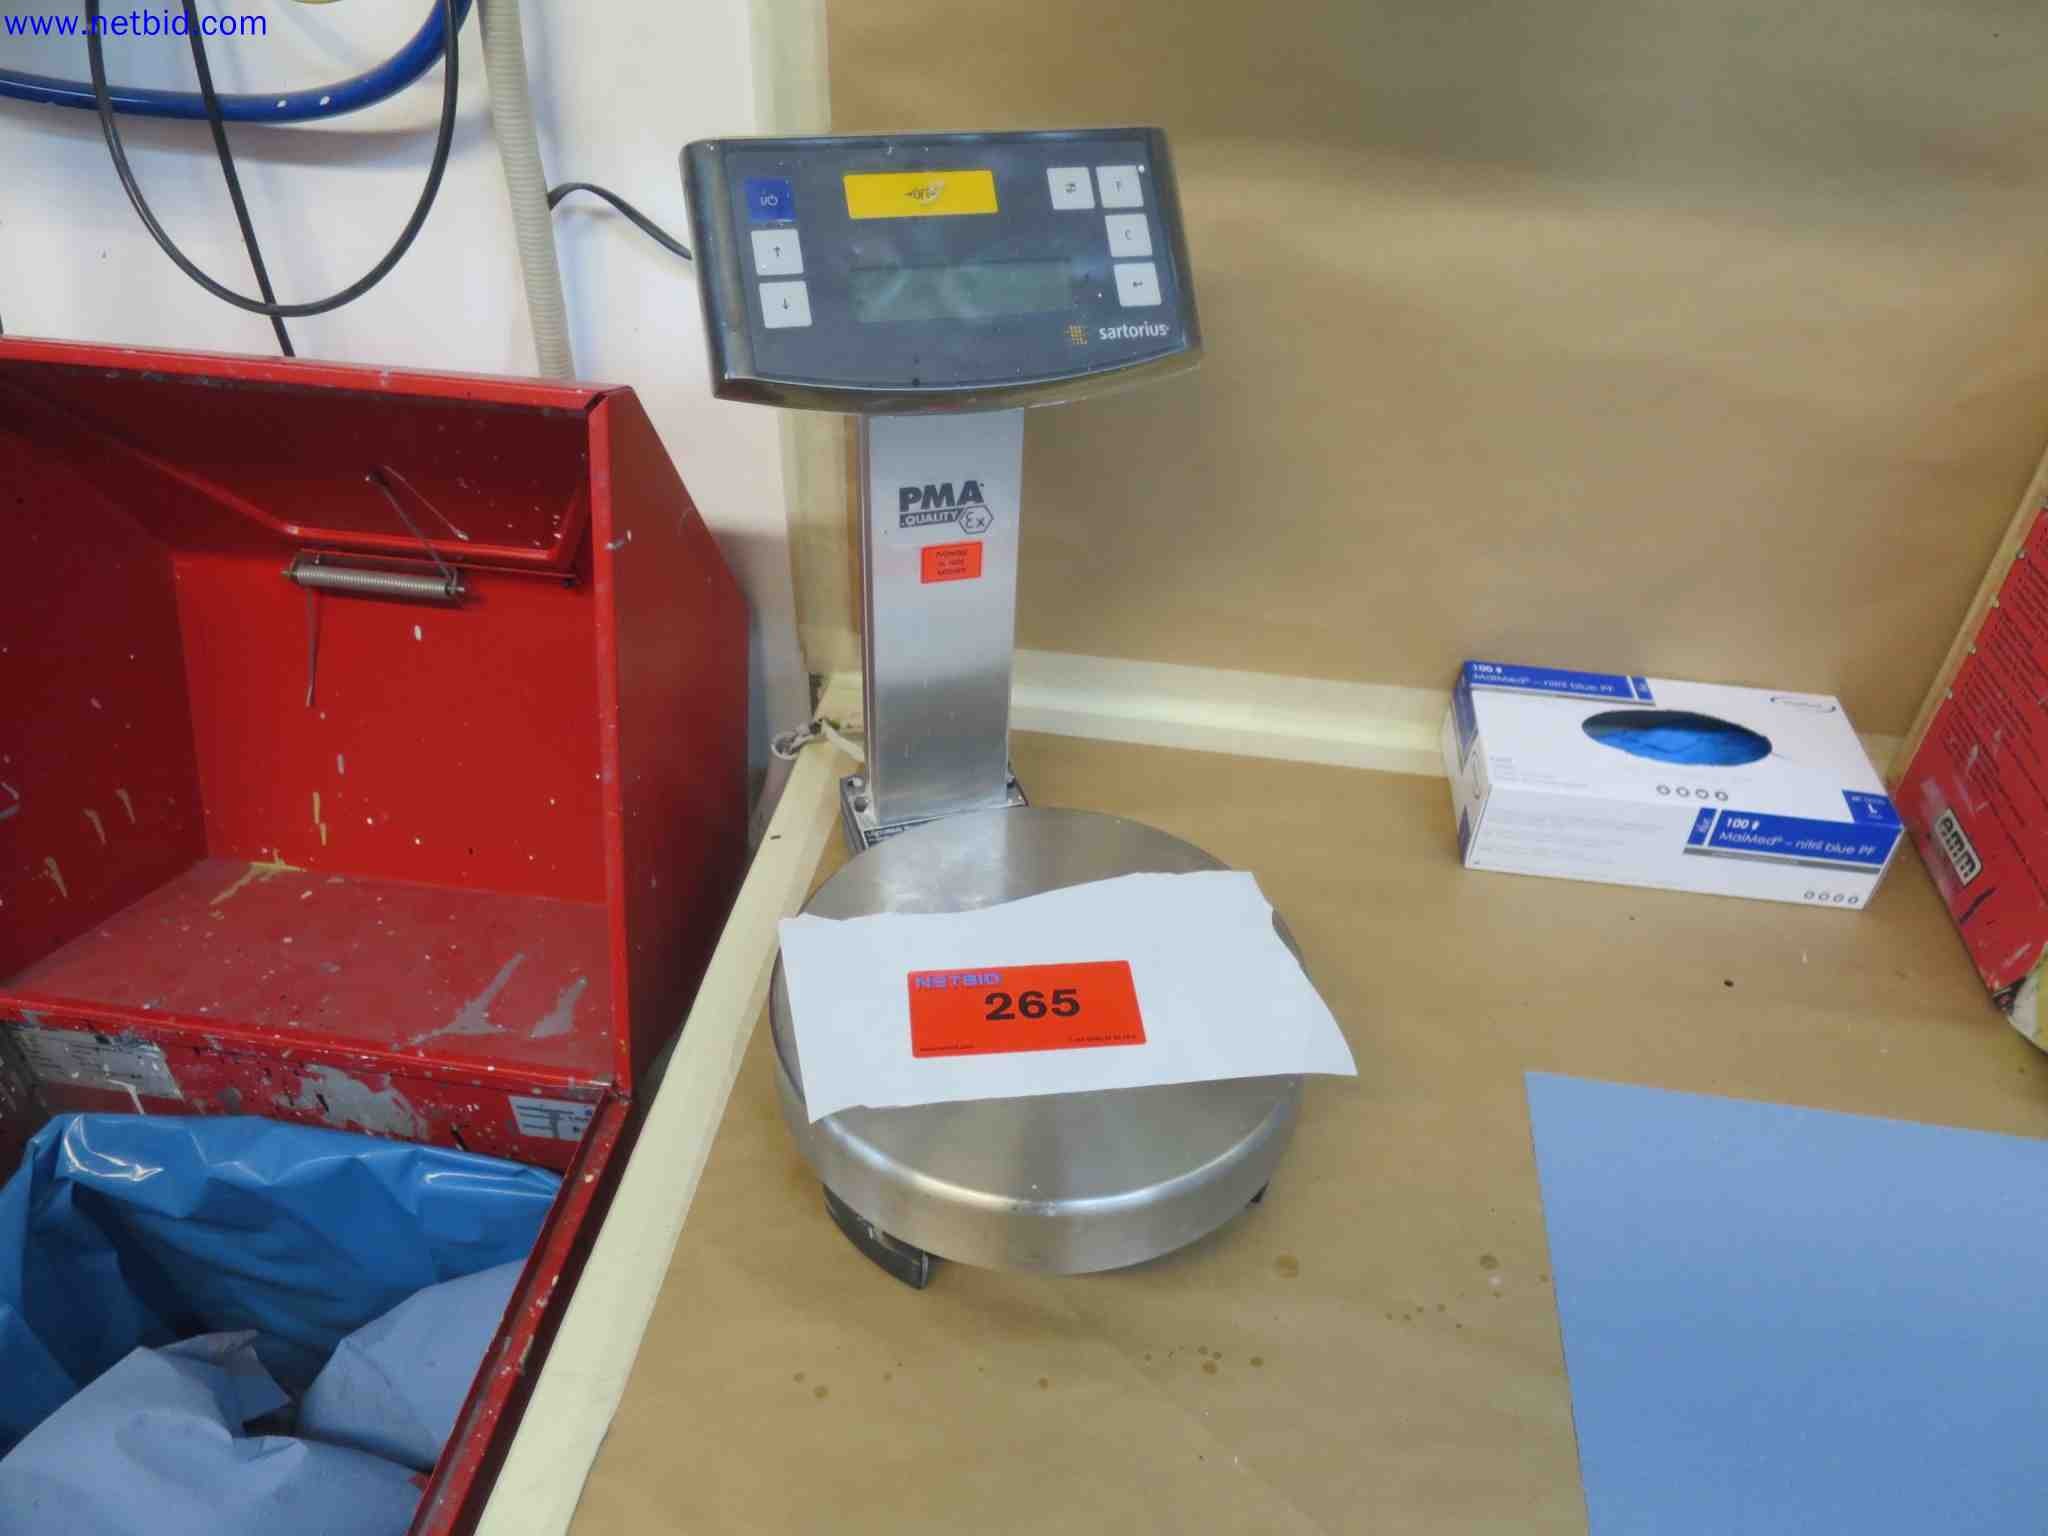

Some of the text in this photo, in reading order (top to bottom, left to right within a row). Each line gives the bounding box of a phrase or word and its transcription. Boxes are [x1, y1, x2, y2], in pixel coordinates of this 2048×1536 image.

[1098, 321, 1169, 340] sartorius
[899, 480, 984, 512] PMA
[904, 510, 958, 526] QUALITY
[1725, 818, 1749, 829] 100
[1824, 841, 1856, 855] blue
[1857, 845, 1876, 857] PF
[984, 988, 1081, 1021] 265
